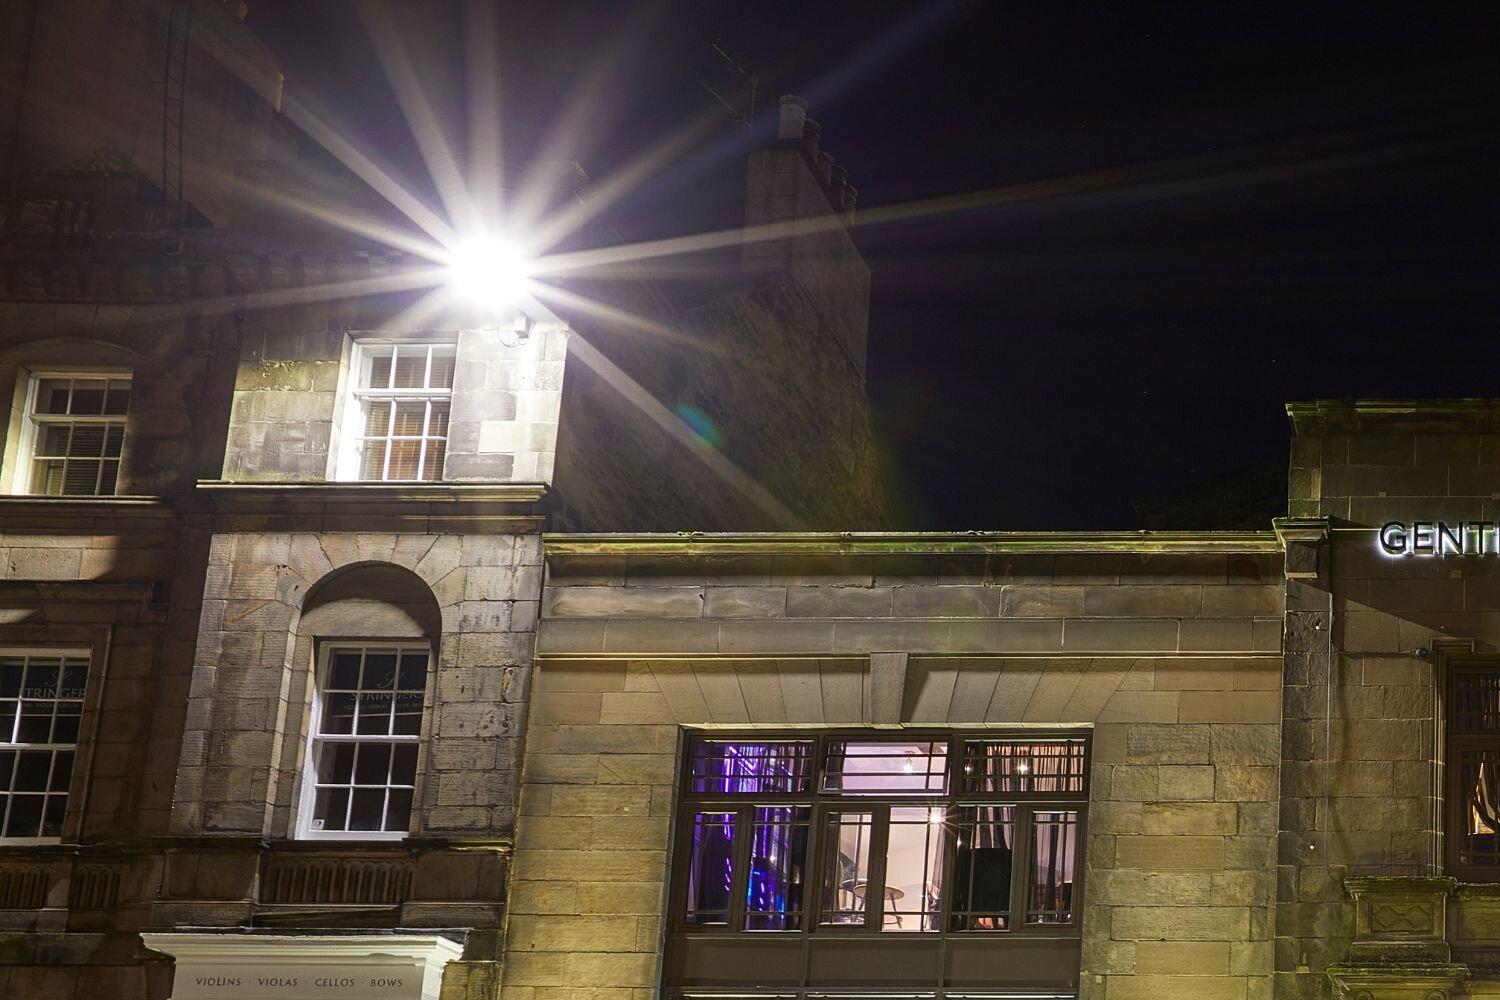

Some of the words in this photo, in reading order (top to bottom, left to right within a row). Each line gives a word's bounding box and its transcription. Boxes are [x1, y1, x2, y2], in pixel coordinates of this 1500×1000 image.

[196, 977, 241, 986] VIOLINS
[257, 978, 298, 987] VIOLAS
[315, 978, 355, 987] CELLOS
[370, 978, 403, 987] BOWS
